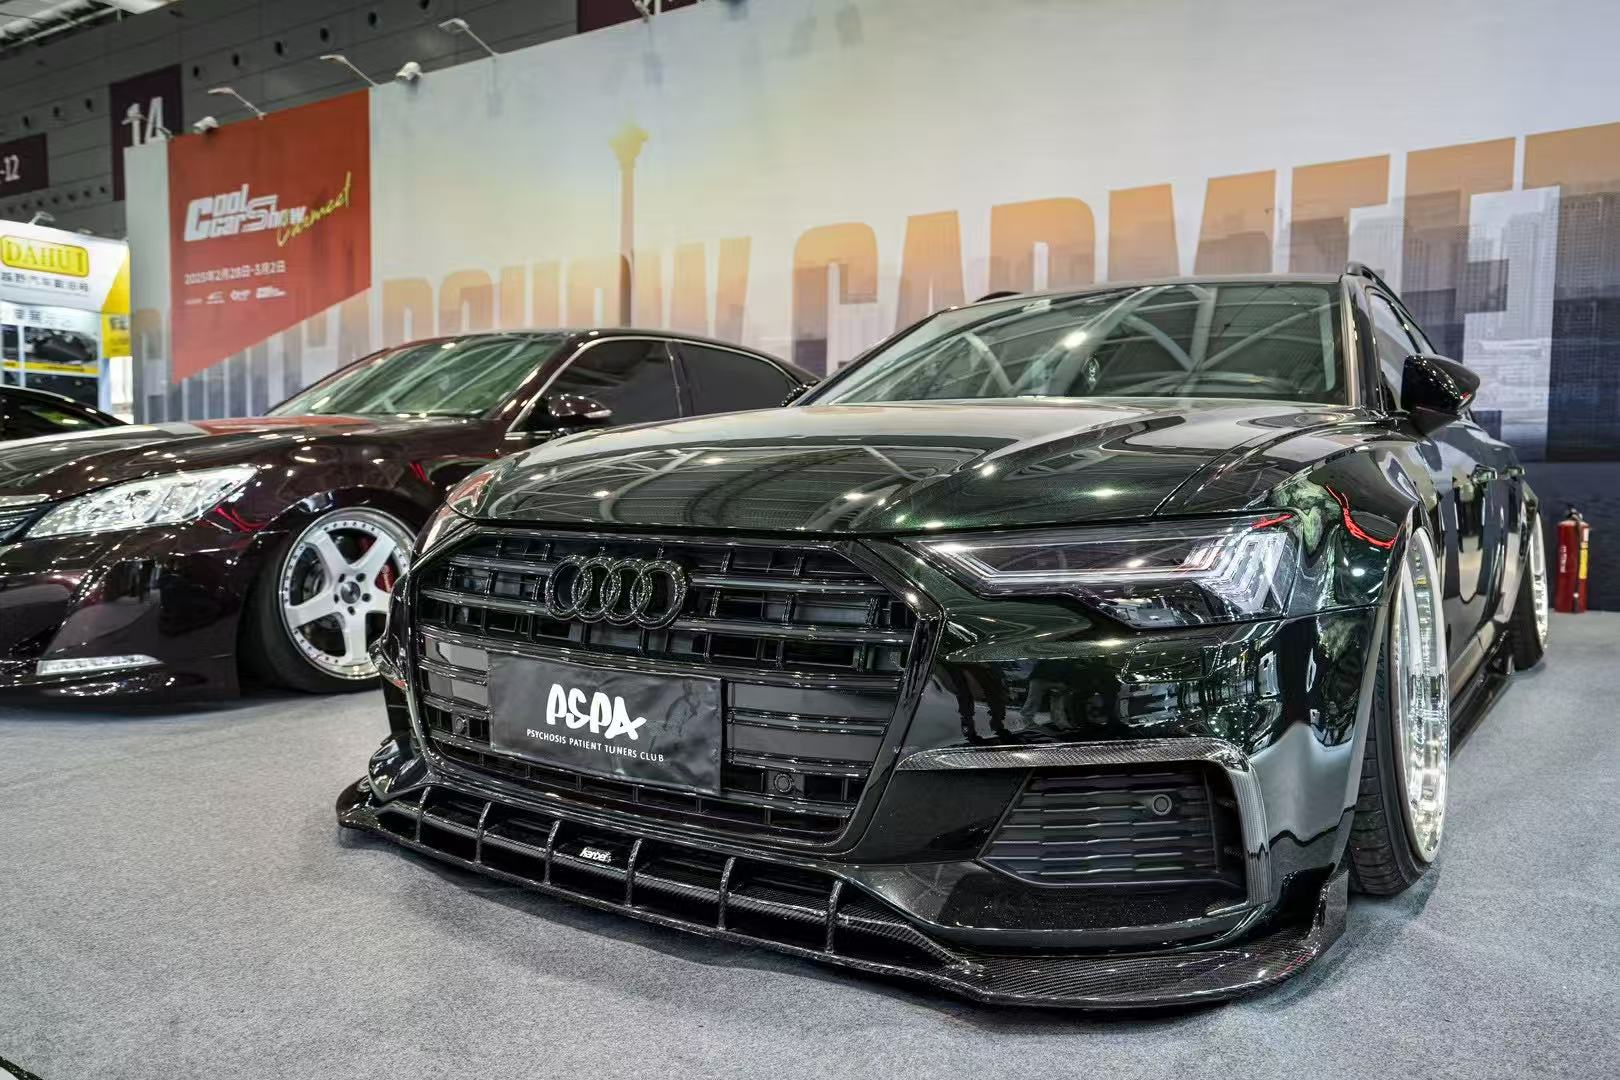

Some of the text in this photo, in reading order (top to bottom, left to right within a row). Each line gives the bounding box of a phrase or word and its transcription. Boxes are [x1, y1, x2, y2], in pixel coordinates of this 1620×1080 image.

[526, 728, 665, 762] PSYCHOSIS PATIENT TUNERS CLUB
